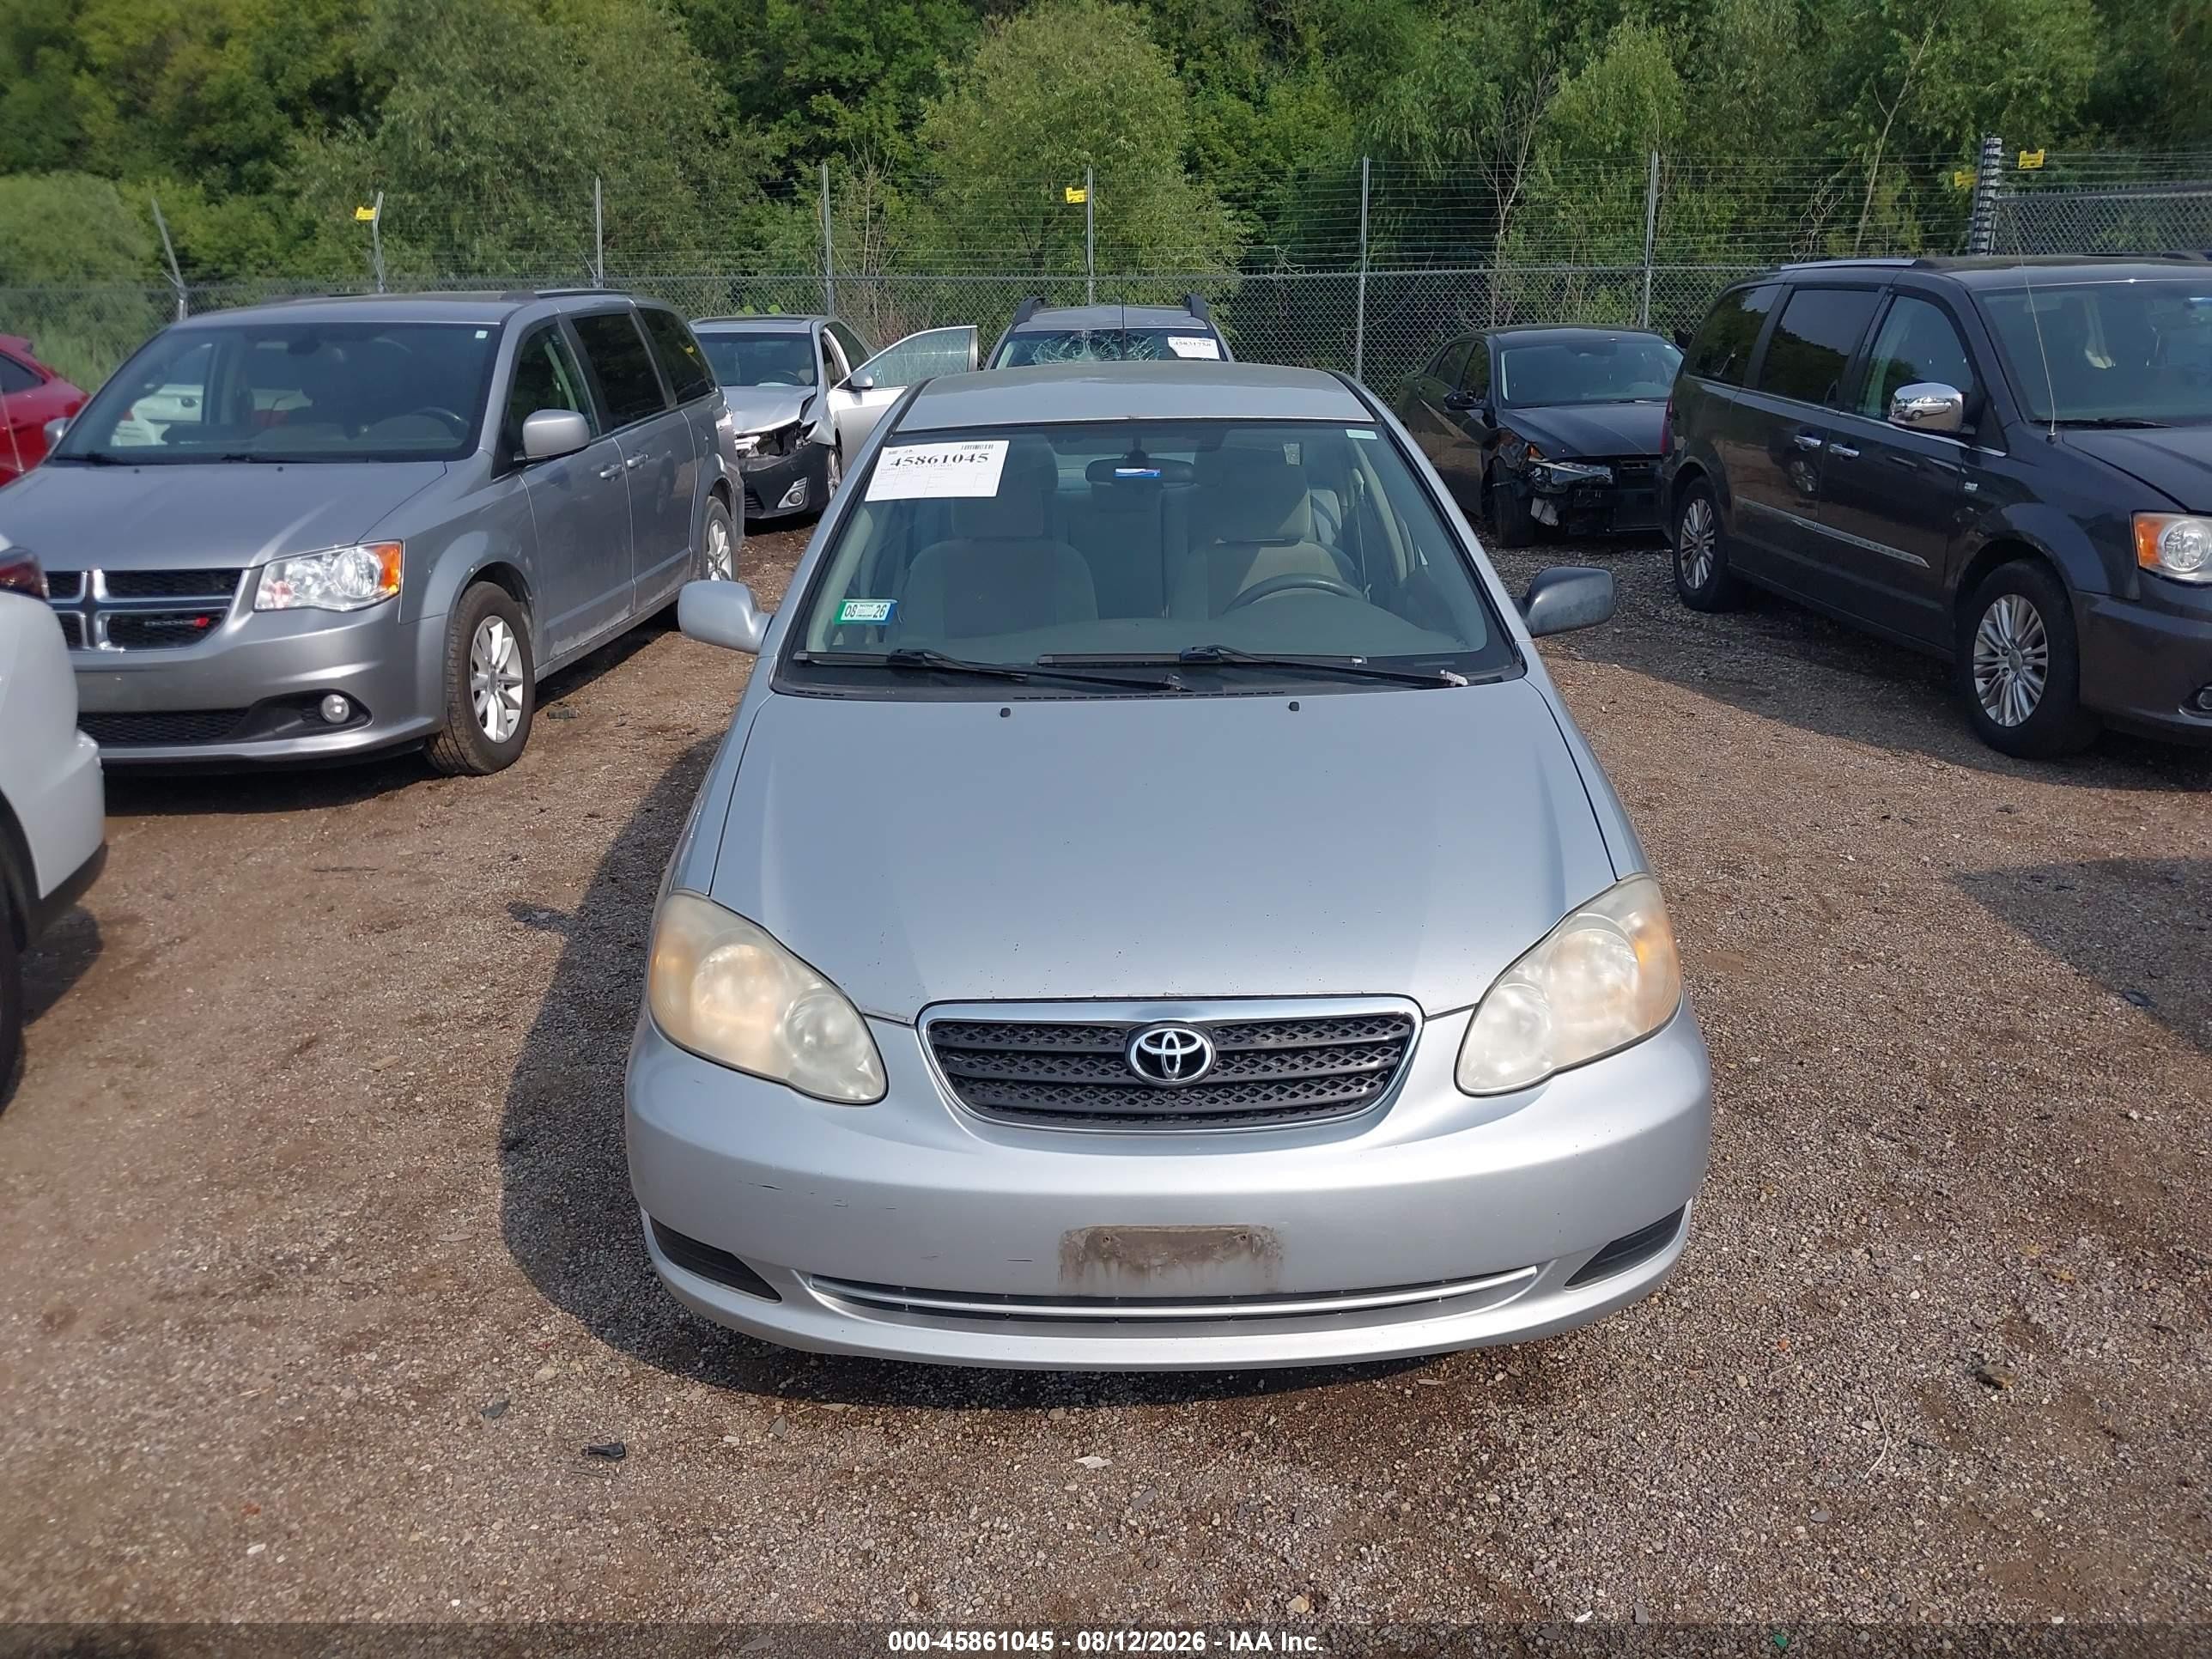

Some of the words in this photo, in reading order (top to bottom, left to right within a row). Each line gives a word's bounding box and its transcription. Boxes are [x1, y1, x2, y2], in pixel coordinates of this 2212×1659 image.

[890, 453, 989, 467] 45861045
[844, 604, 858, 618] 08
[872, 604, 887, 618] 26
